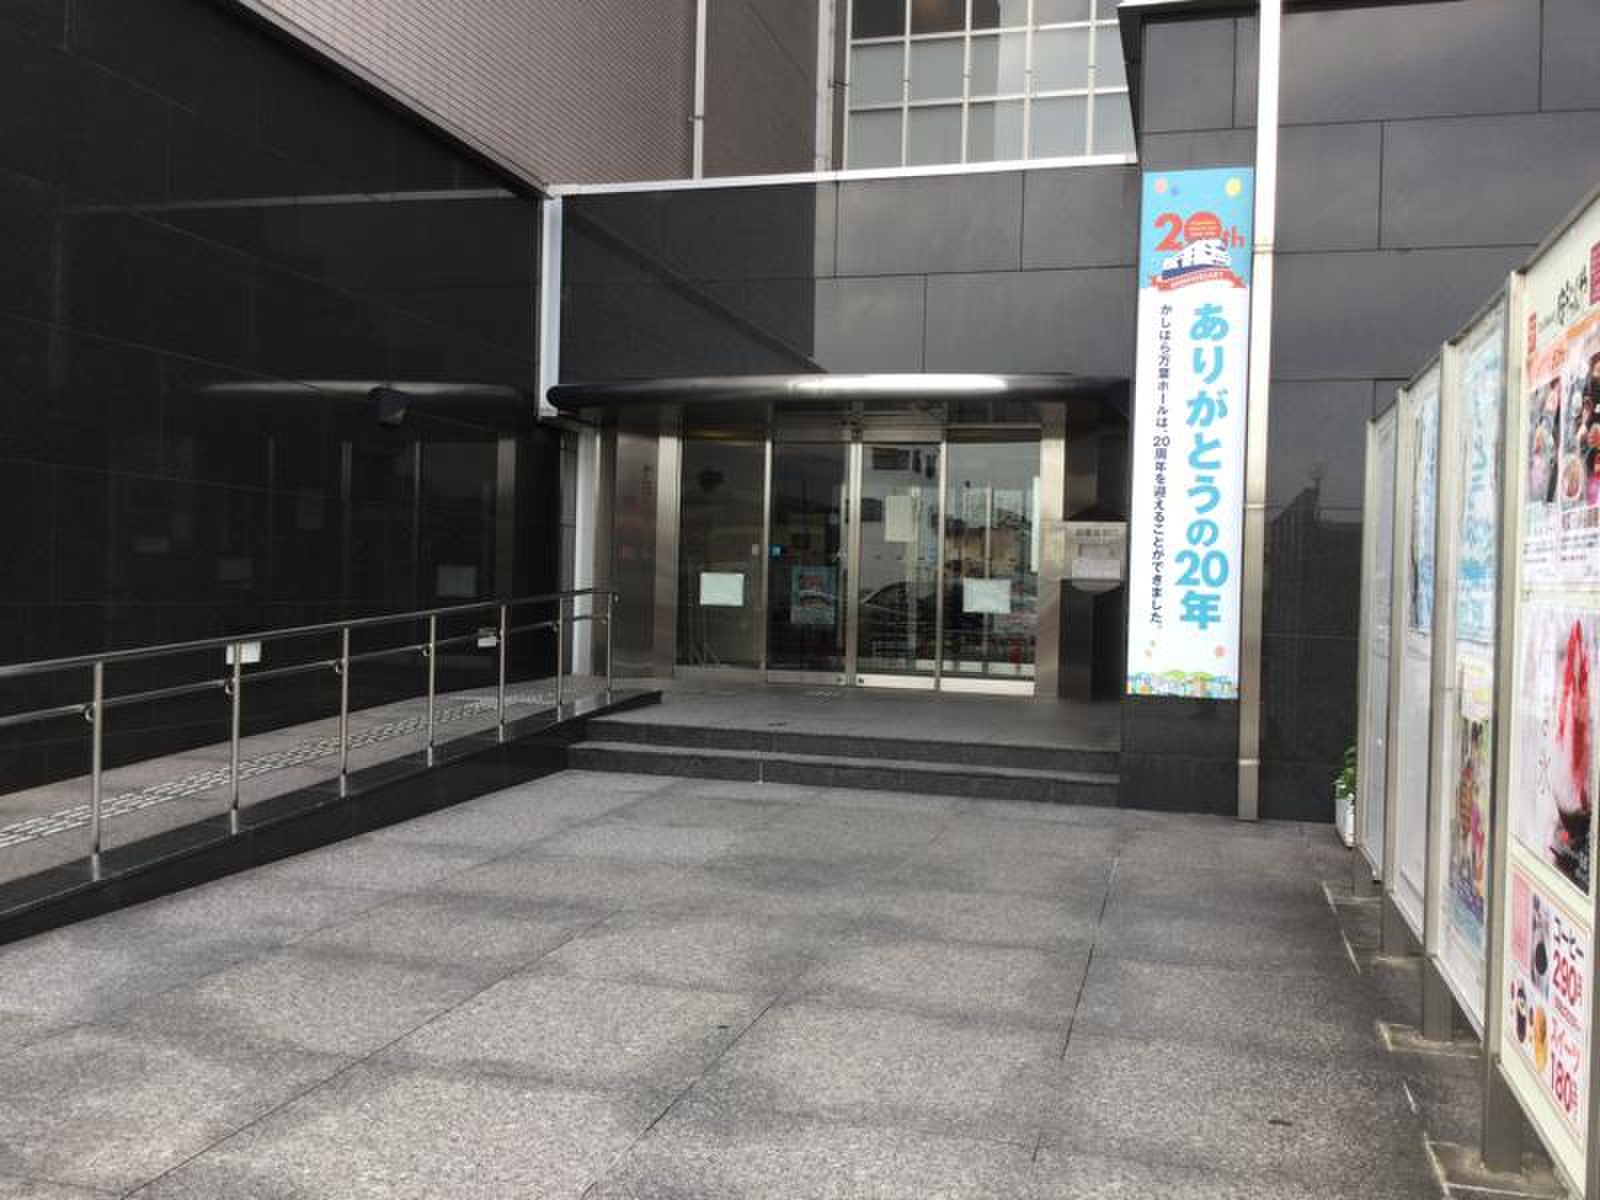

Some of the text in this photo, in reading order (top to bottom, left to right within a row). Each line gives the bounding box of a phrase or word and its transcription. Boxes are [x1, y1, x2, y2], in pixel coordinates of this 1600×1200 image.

[1174, 303, 1230, 630] ありがとうの20年
